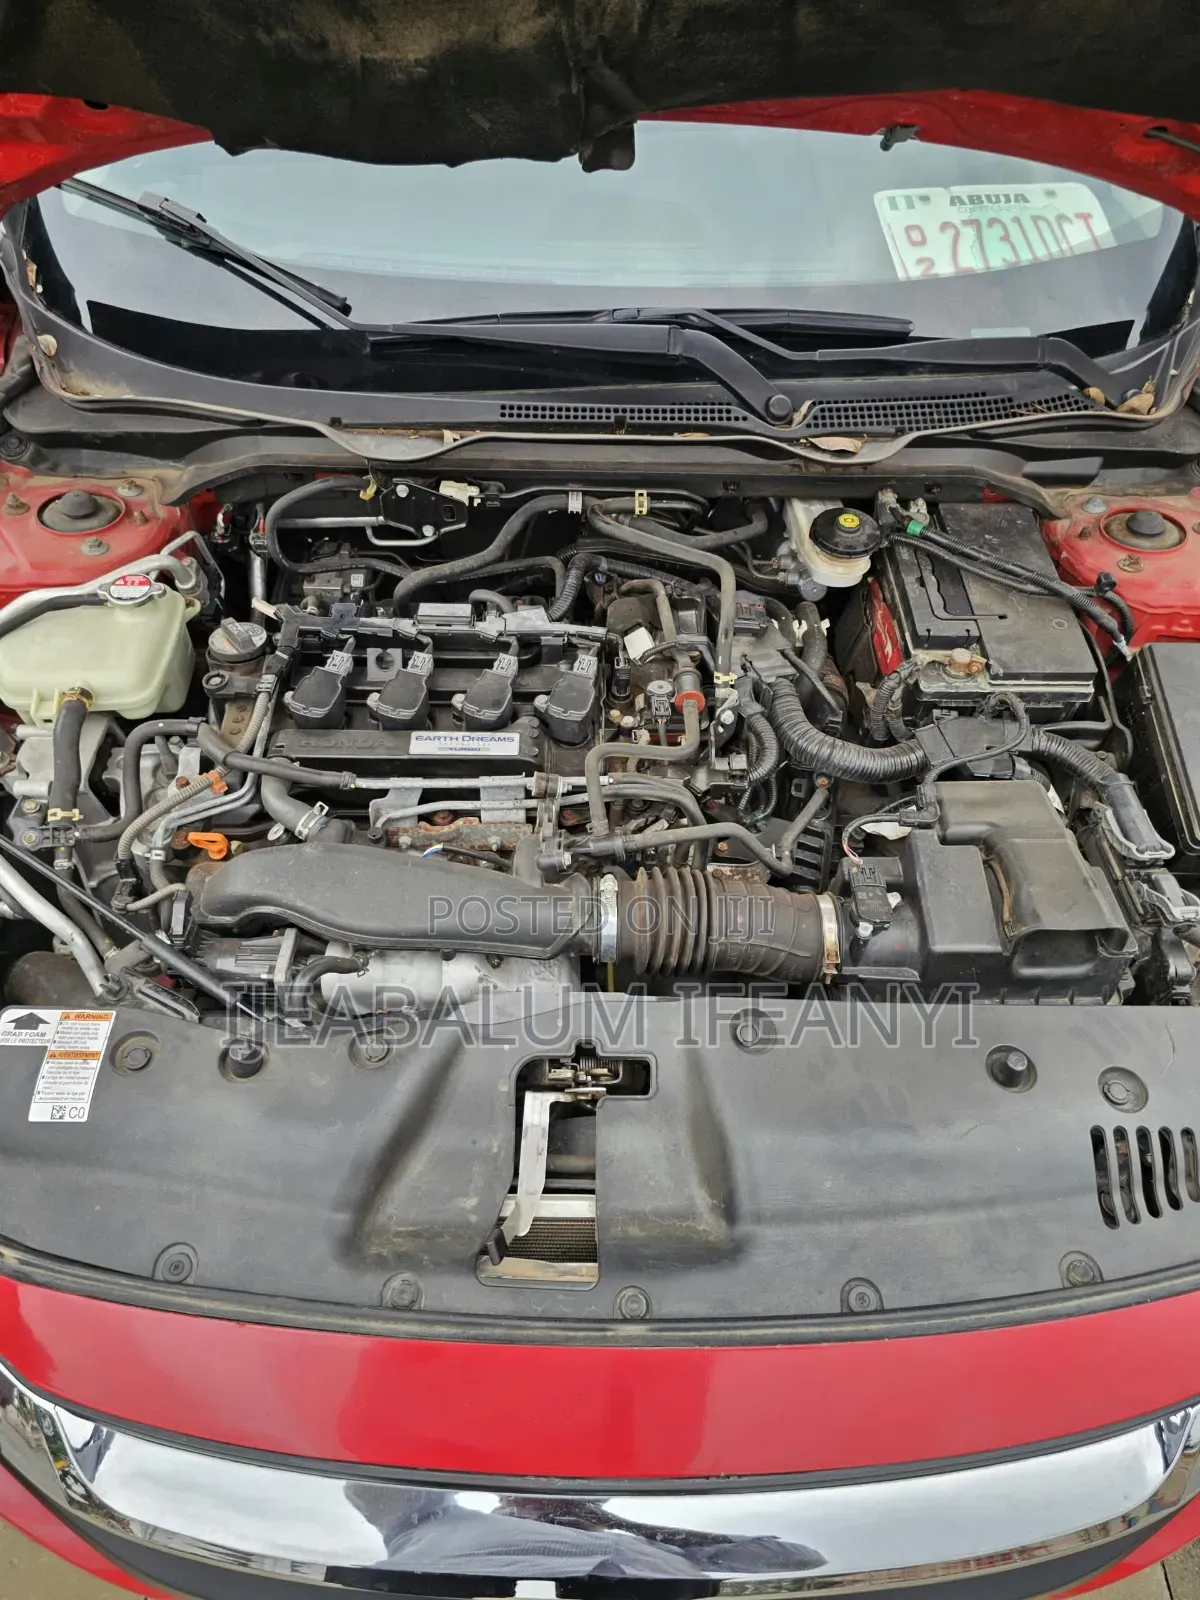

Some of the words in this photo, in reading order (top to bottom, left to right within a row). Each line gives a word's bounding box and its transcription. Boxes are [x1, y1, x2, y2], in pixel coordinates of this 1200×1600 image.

[949, 193, 1031, 207] ABUJA
[461, 735, 515, 743] DREAMS
[1, 1030, 24, 1038] GRAB
